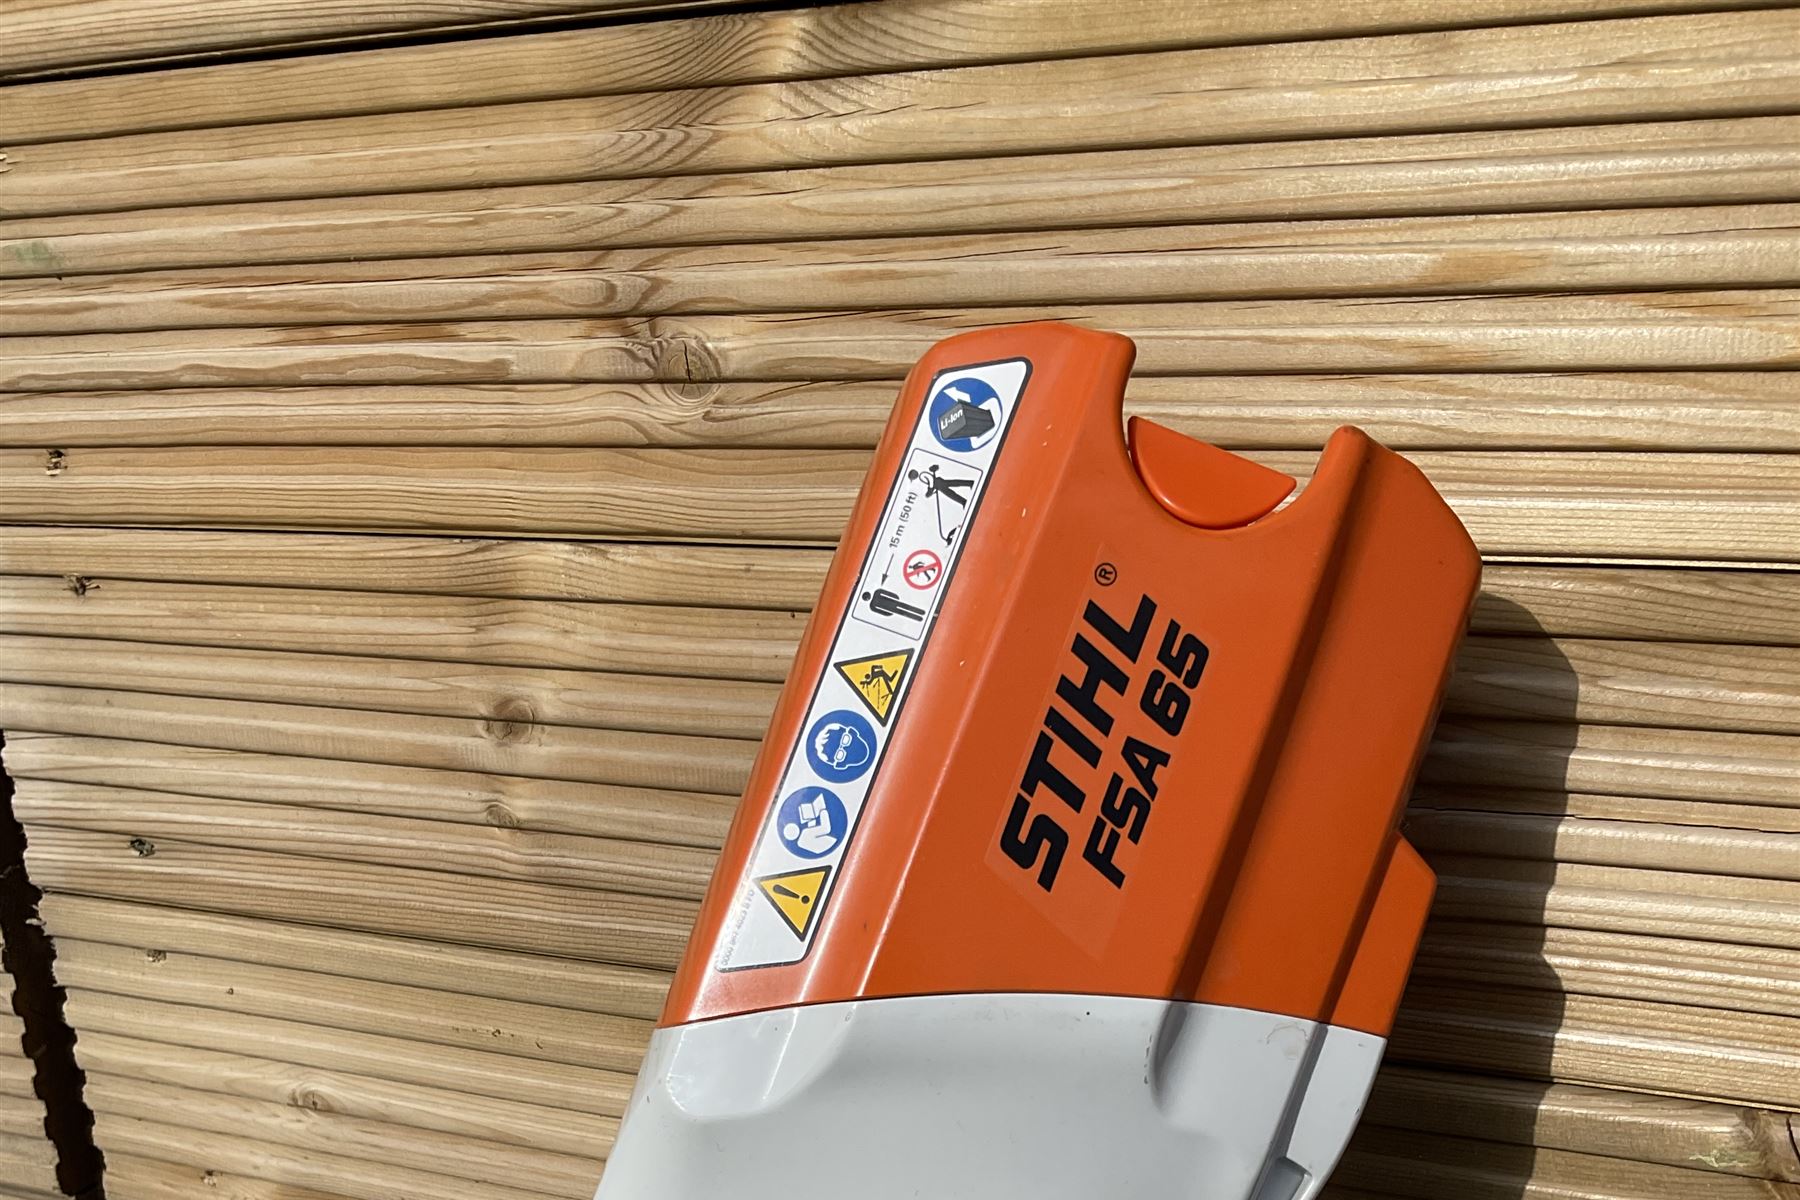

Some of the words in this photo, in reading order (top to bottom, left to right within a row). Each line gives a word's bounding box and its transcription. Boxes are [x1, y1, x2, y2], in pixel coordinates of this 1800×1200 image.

[905, 491, 918, 505] ft)
[899, 505, 912, 523] (50
[896, 525, 905, 537] m
[888, 535, 900, 549] 15
[1082, 735, 1171, 889] FSA
[1139, 618, 1210, 737] 65
